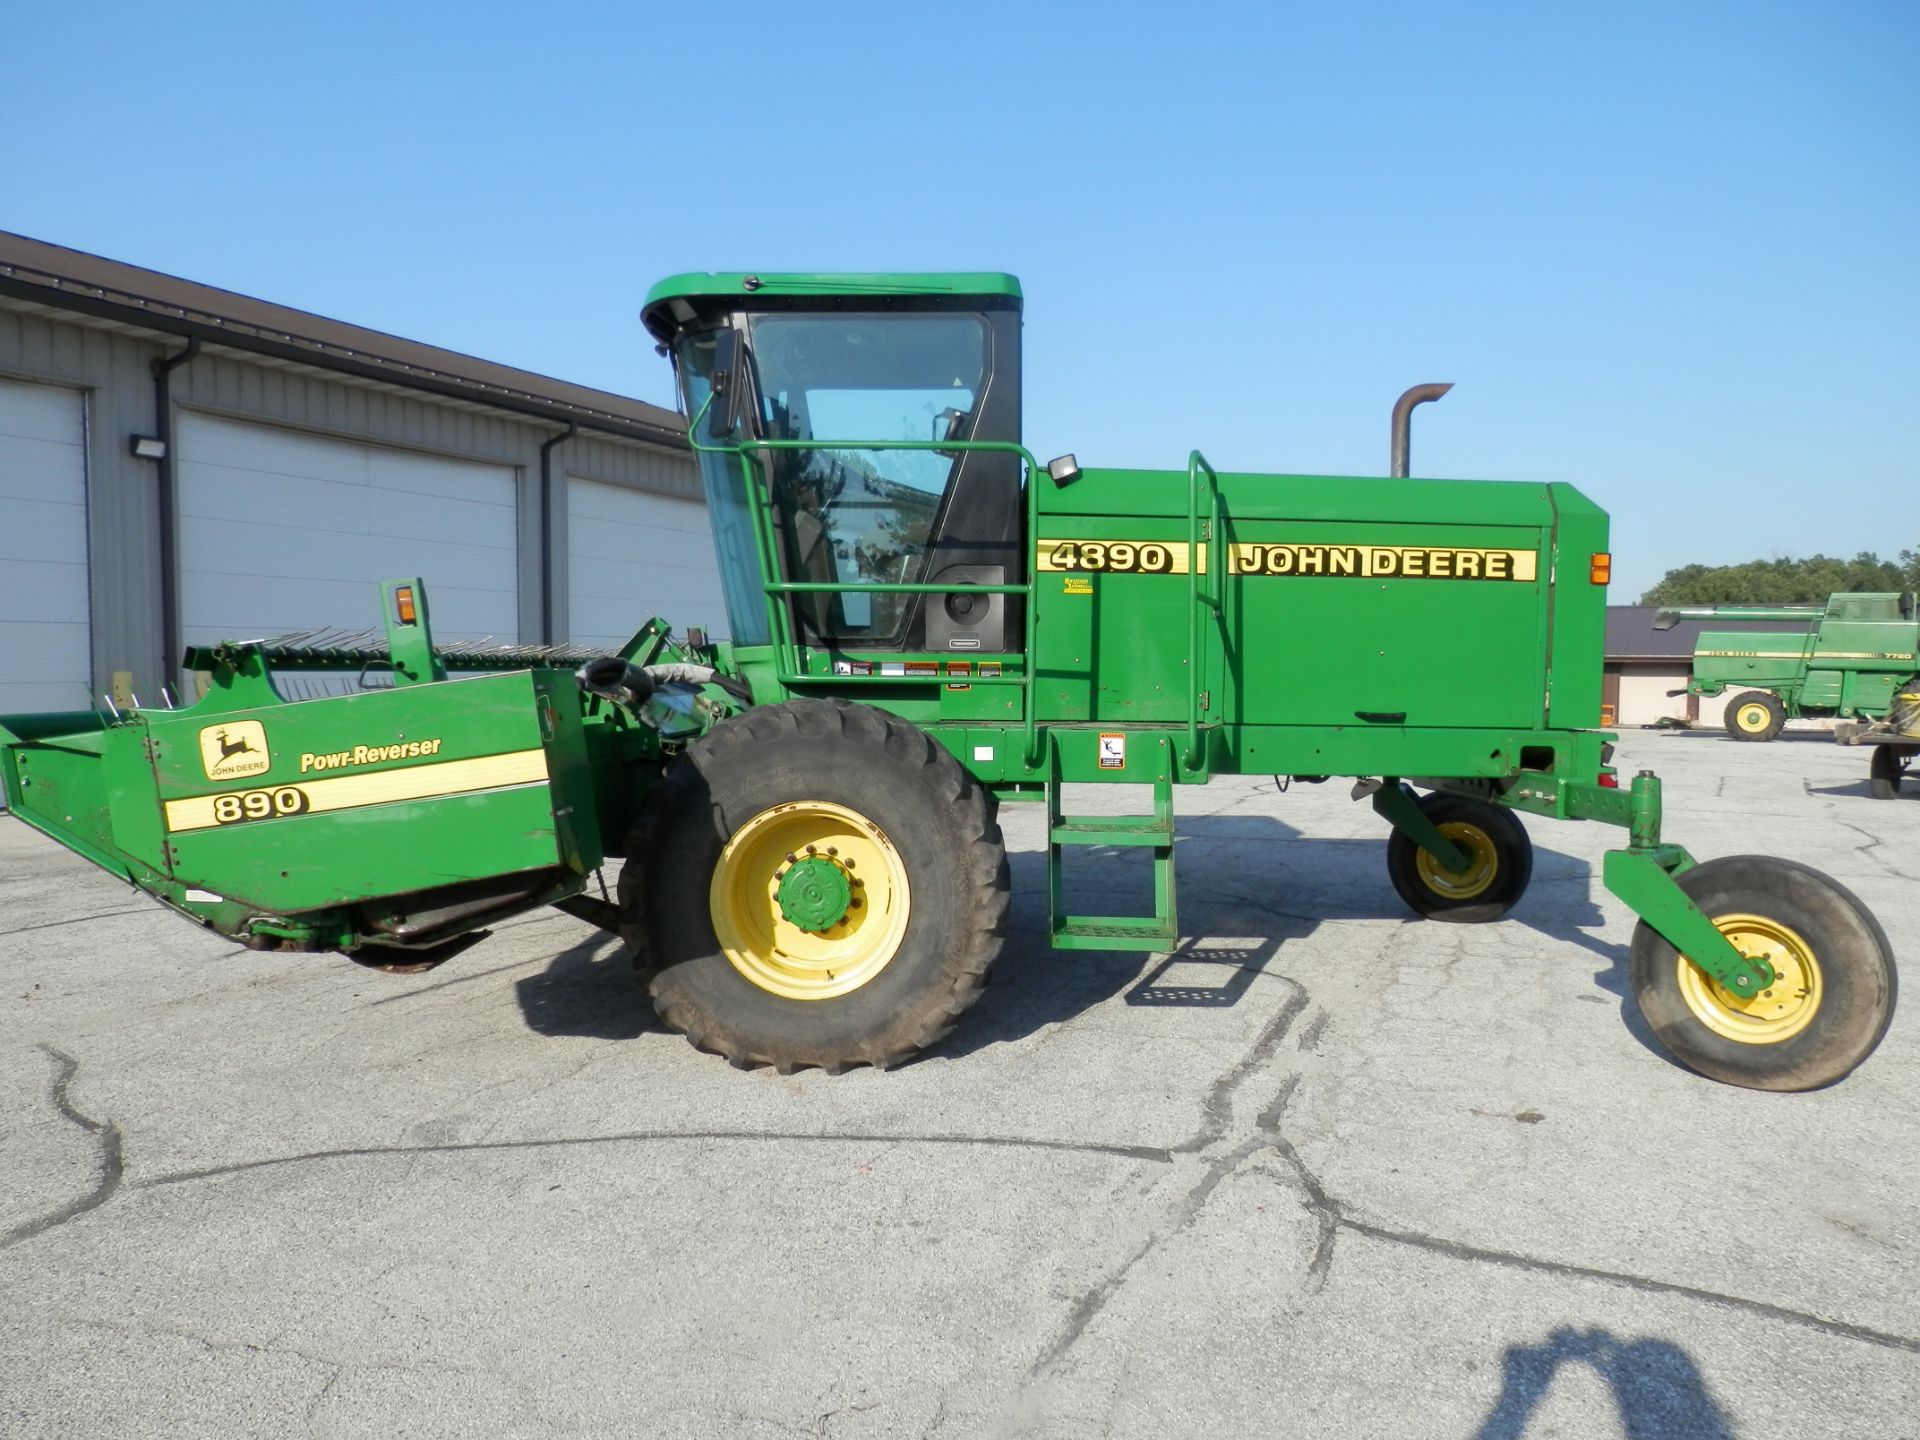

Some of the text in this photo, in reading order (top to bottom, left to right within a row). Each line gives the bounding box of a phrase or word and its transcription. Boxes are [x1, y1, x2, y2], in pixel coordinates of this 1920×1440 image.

[1051, 543, 1173, 572] 4890
[1238, 546, 1513, 579] JOHN DEERE
[211, 762, 266, 776] JOHN DEERE
[301, 738, 442, 773] Powr-Reverser
[214, 787, 310, 825] 890
